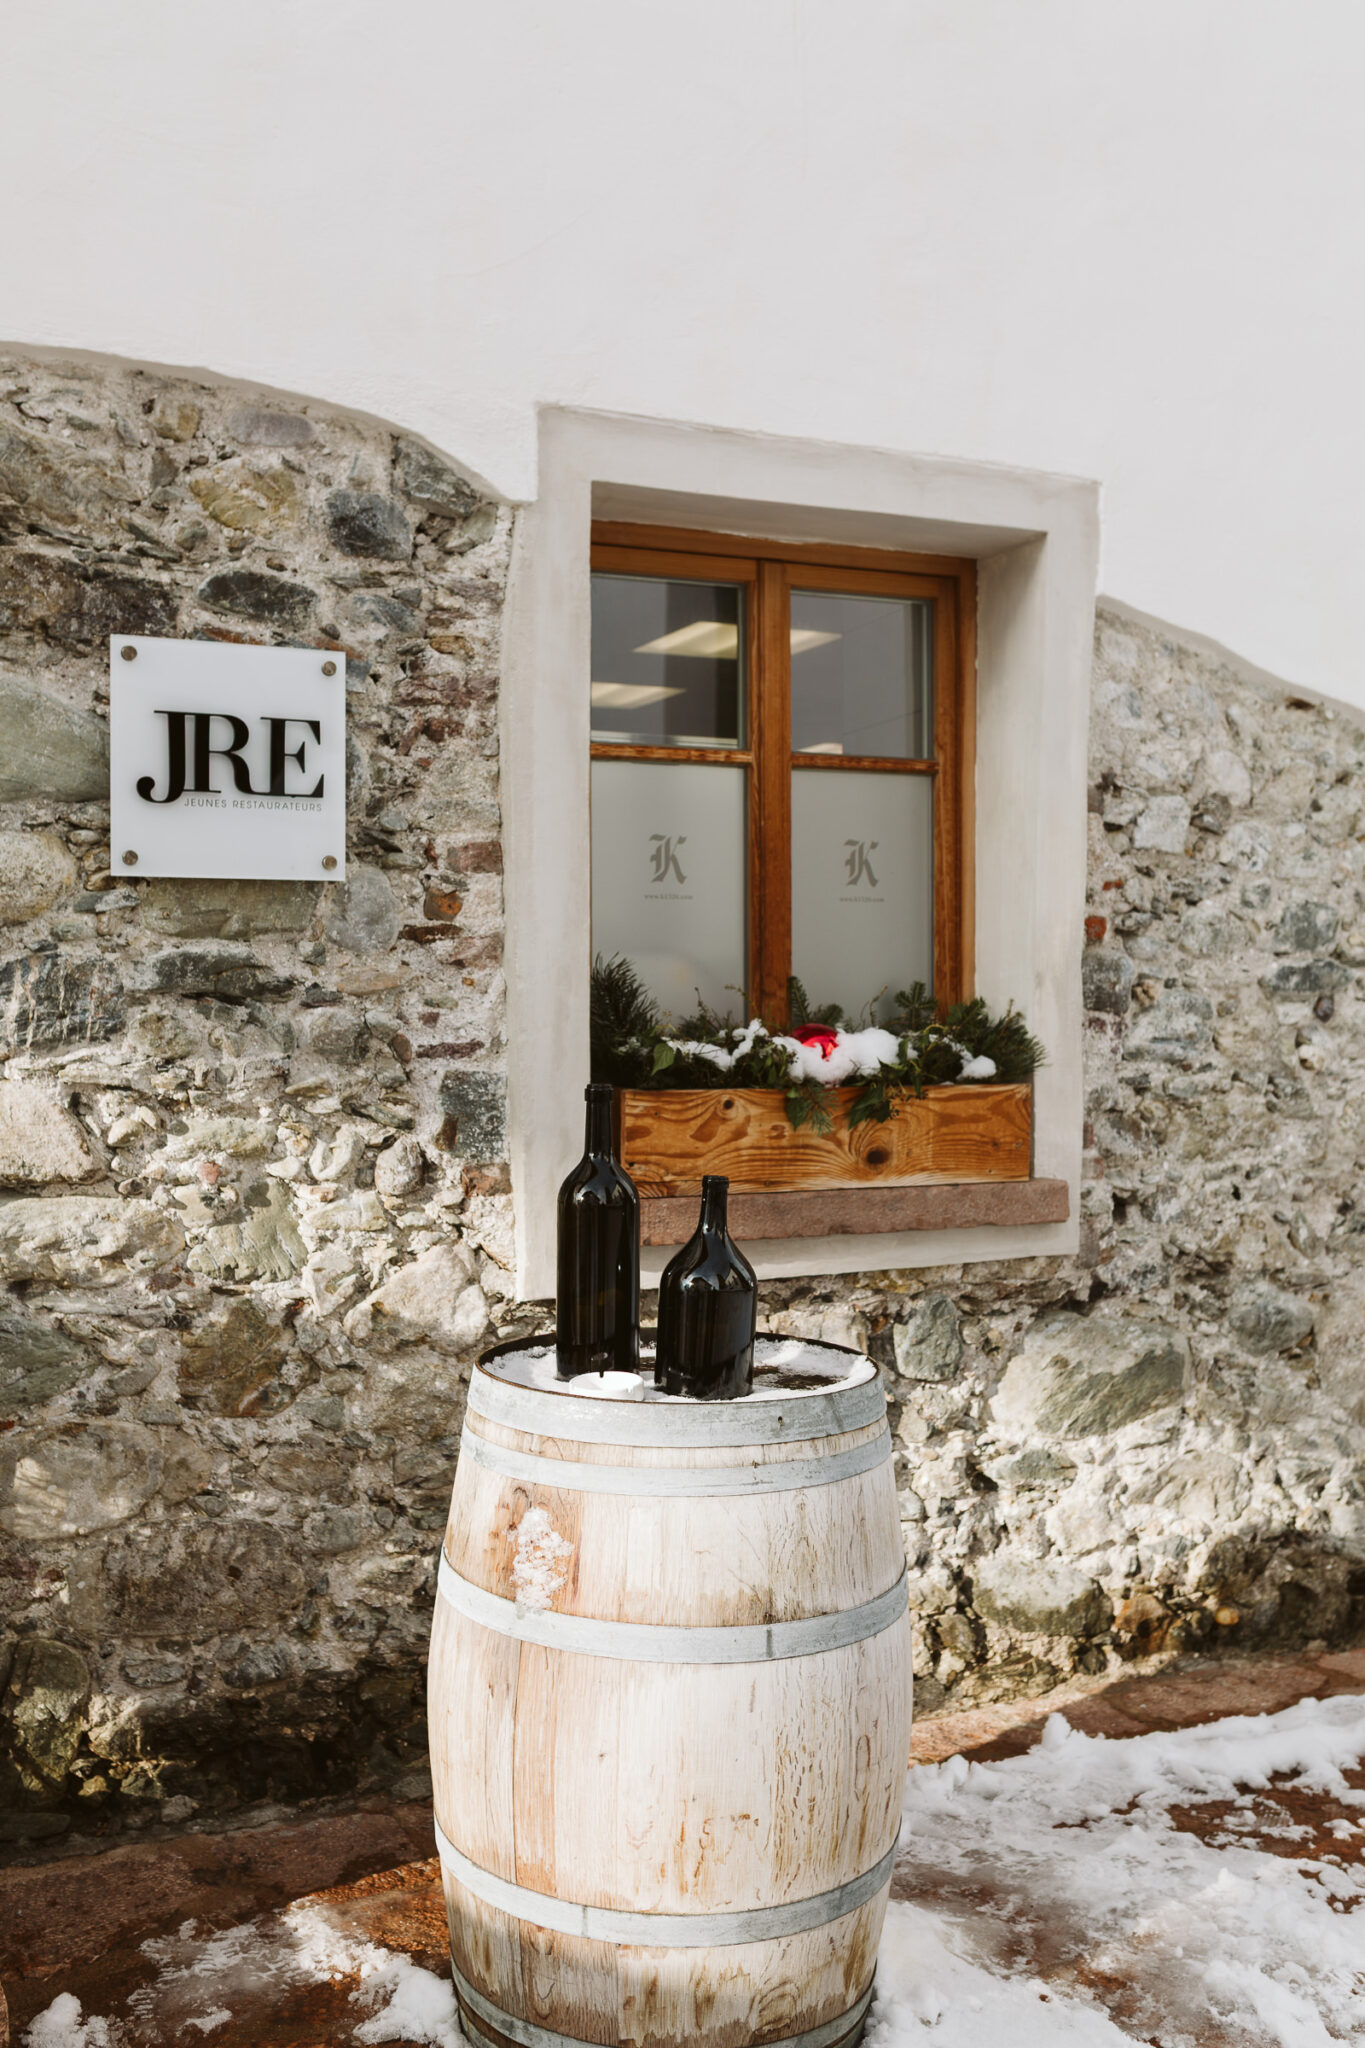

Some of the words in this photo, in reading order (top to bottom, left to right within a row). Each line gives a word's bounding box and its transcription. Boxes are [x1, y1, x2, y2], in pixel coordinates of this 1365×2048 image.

[136, 710, 324, 804] JRE
[184, 798, 227, 809] JEUNES
[232, 800, 322, 812] RESTAURATEURS
[649, 834, 687, 885] K
[844, 839, 879, 888] K
